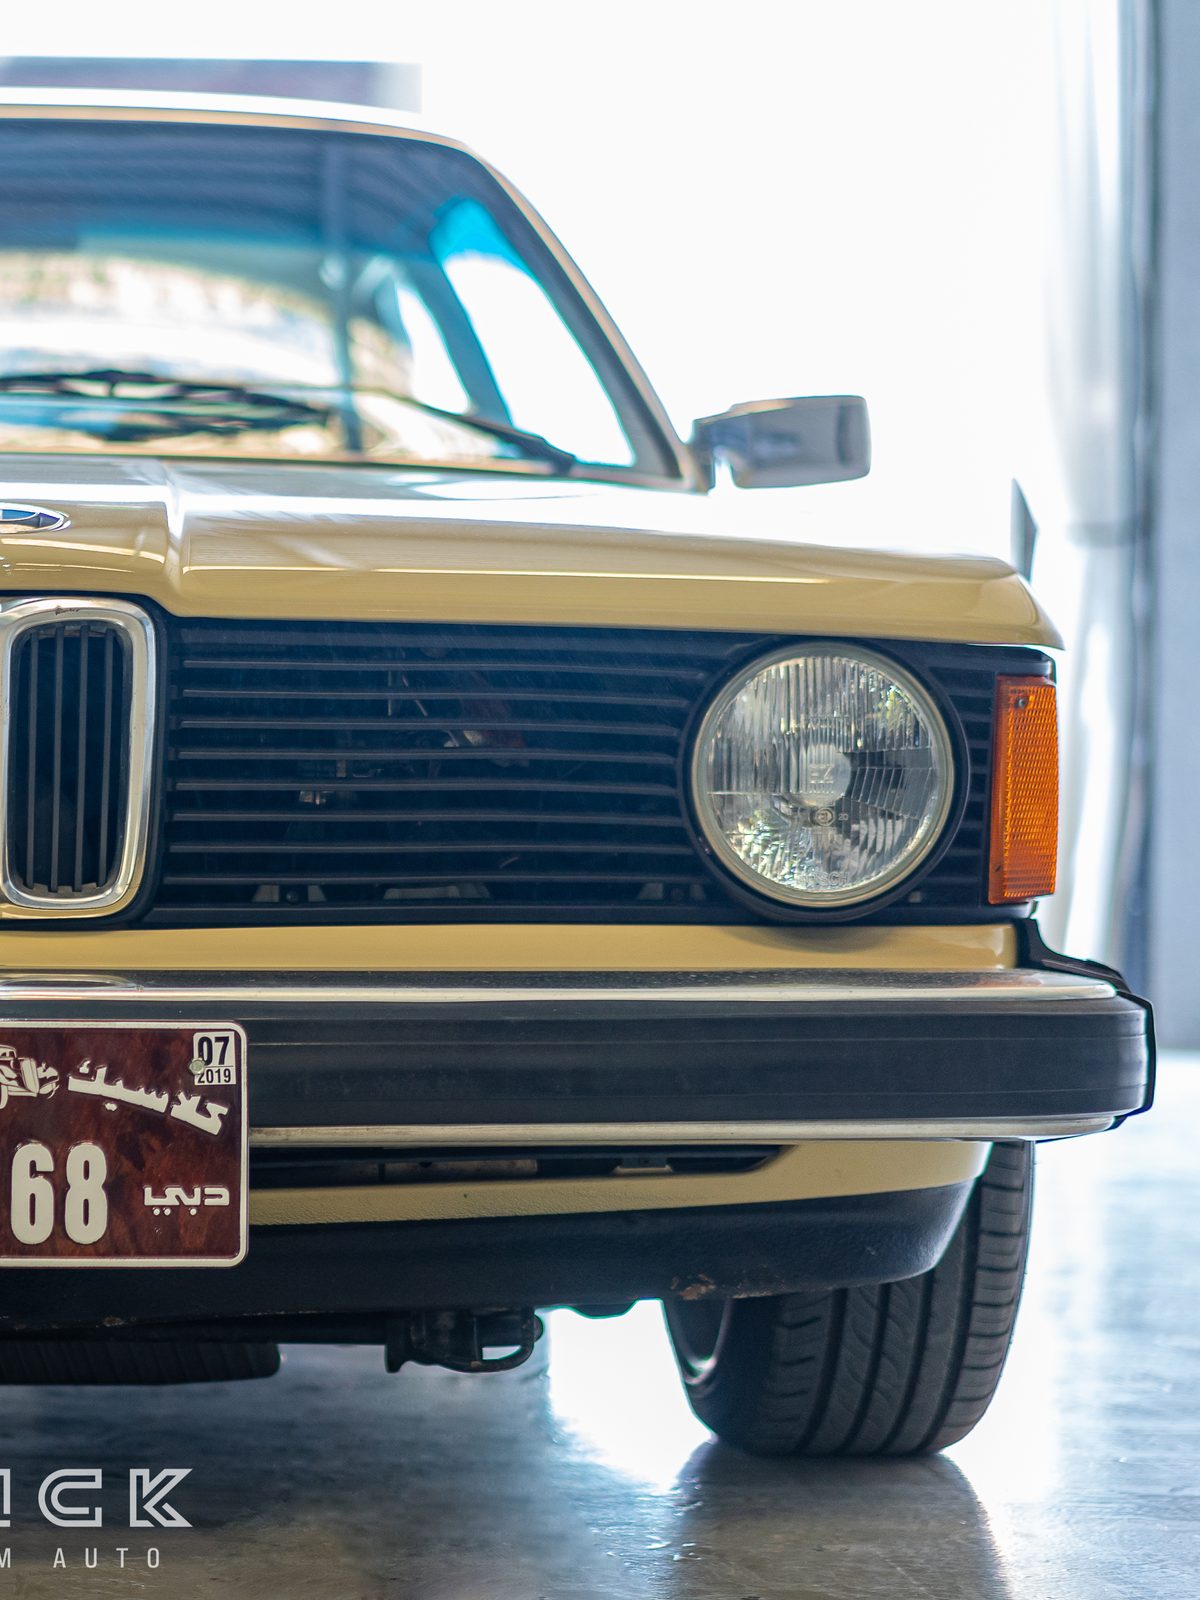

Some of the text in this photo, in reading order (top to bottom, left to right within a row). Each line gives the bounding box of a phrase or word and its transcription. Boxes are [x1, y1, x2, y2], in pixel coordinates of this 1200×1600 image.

[197, 1035, 230, 1067] 07
[197, 1068, 231, 1084] 2019
[67, 1059, 231, 1136] كلاسيك
[143, 1185, 231, 1216] دبي
